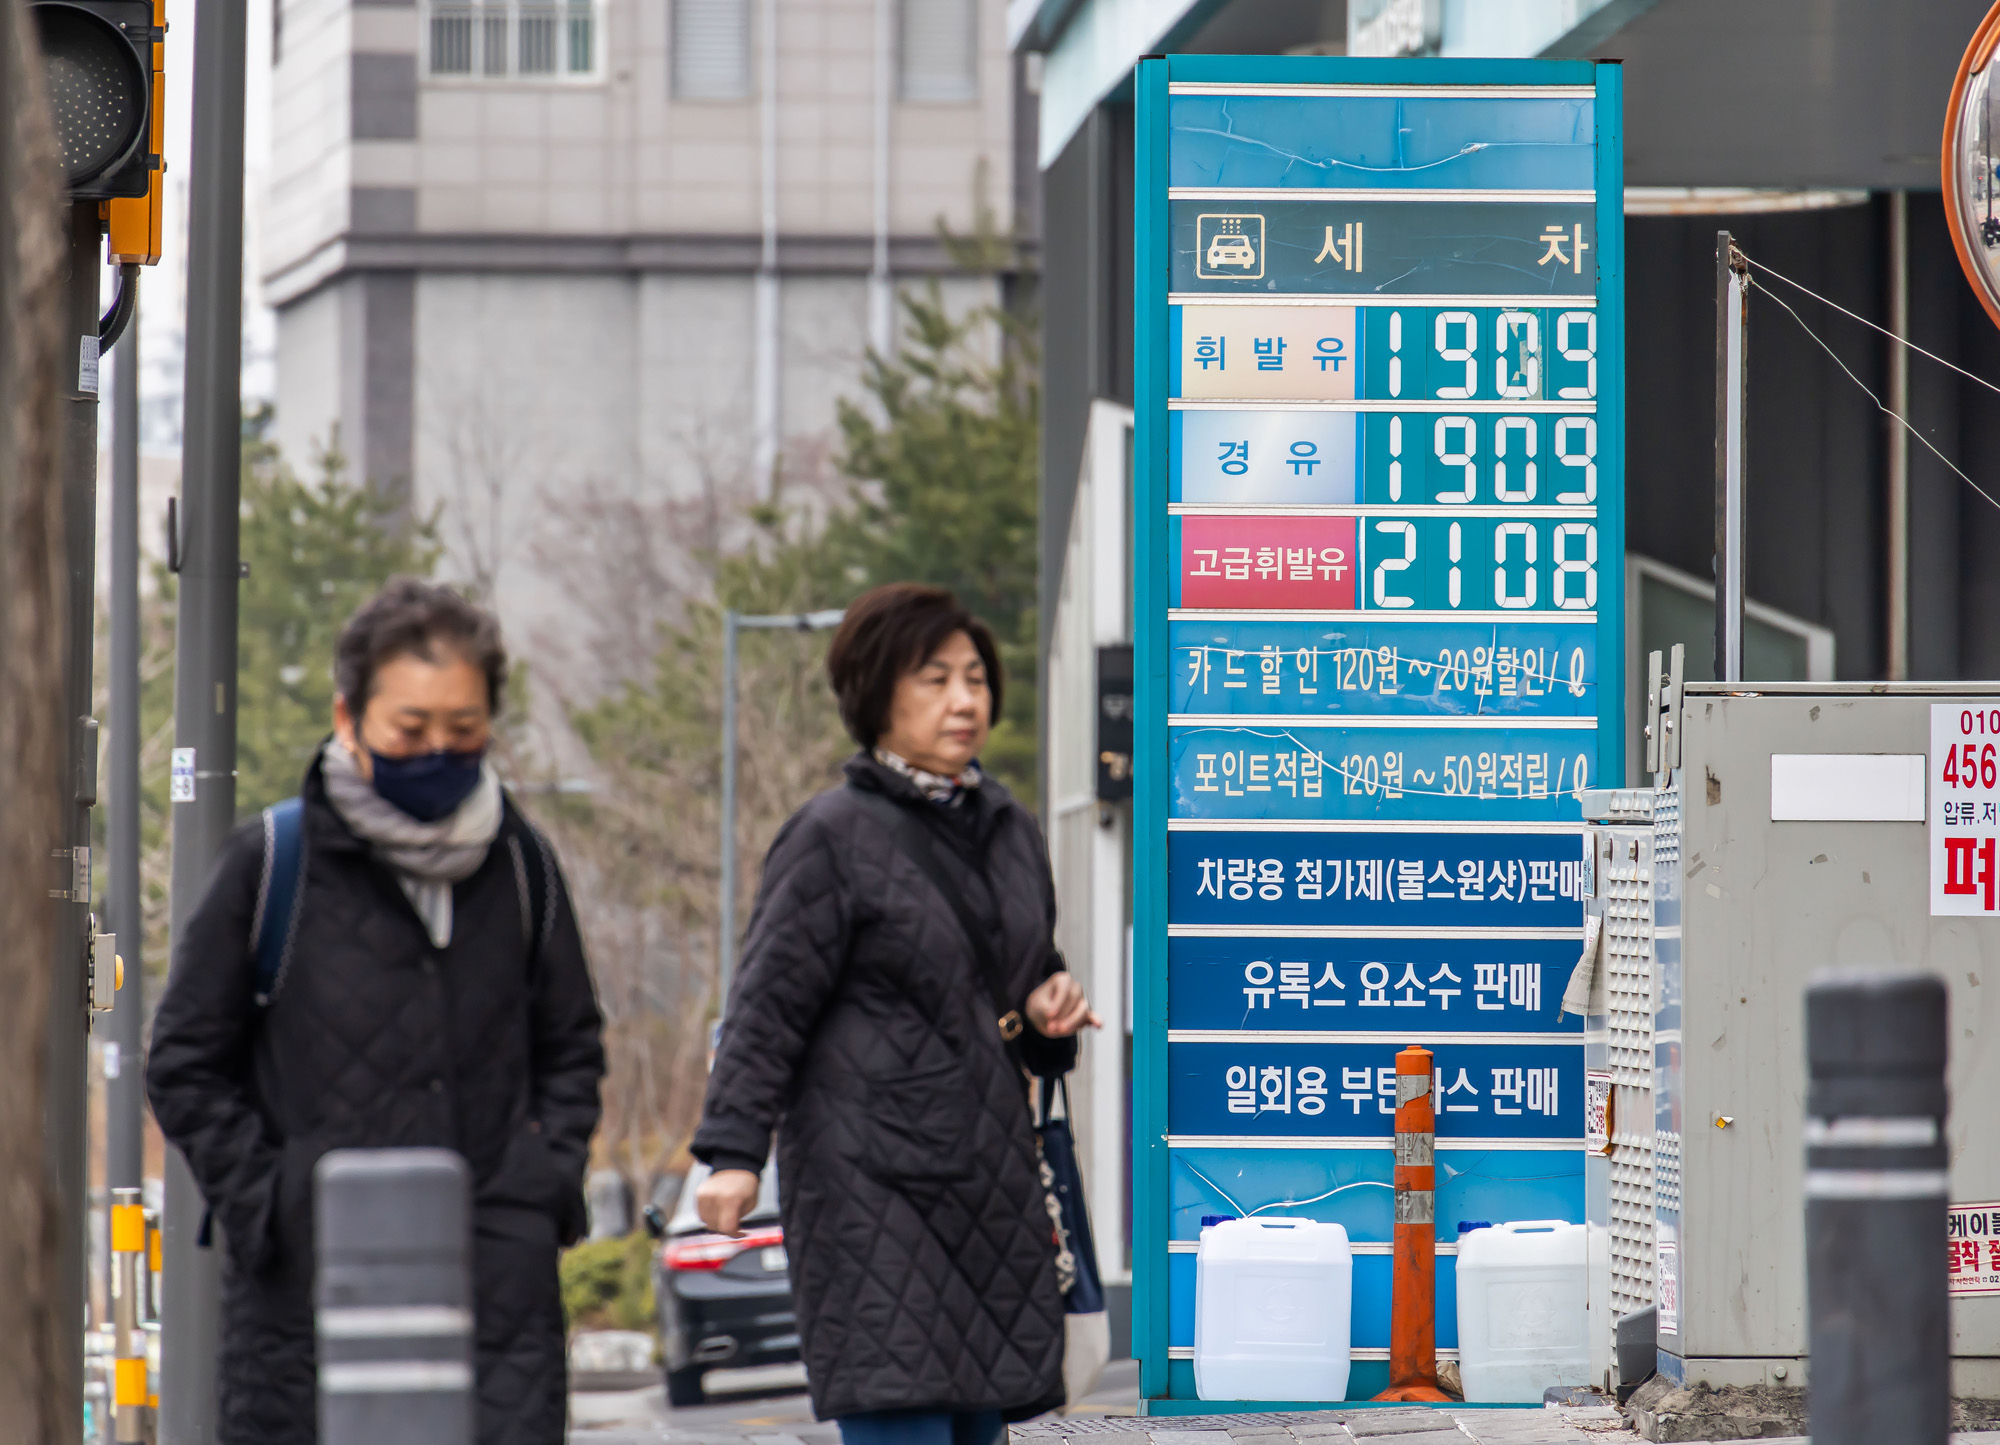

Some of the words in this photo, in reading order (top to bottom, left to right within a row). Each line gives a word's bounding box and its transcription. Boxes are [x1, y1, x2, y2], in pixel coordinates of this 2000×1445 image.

[1389, 311, 1597, 399] 1909
[1389, 415, 1597, 504] 1909
[1190, 547, 1348, 581] 고급휘발유
[1373, 521, 1597, 609] 2108
[1333, 645, 1398, 696] 120원
[1194, 750, 1324, 798] 포인트적립
[1341, 751, 1404, 800] 120원
[1943, 743, 1997, 790] 456
[1197, 858, 1285, 901] 차량용
[1295, 858, 1585, 903] 첨가제(불스원샷)판매
[1243, 961, 1346, 1010] 유록스
[1359, 961, 1462, 1011] 요소수
[1473, 963, 1541, 1012] 판매
[1226, 1066, 1328, 1115] 일회용
[1491, 1067, 1559, 1116] 판매
